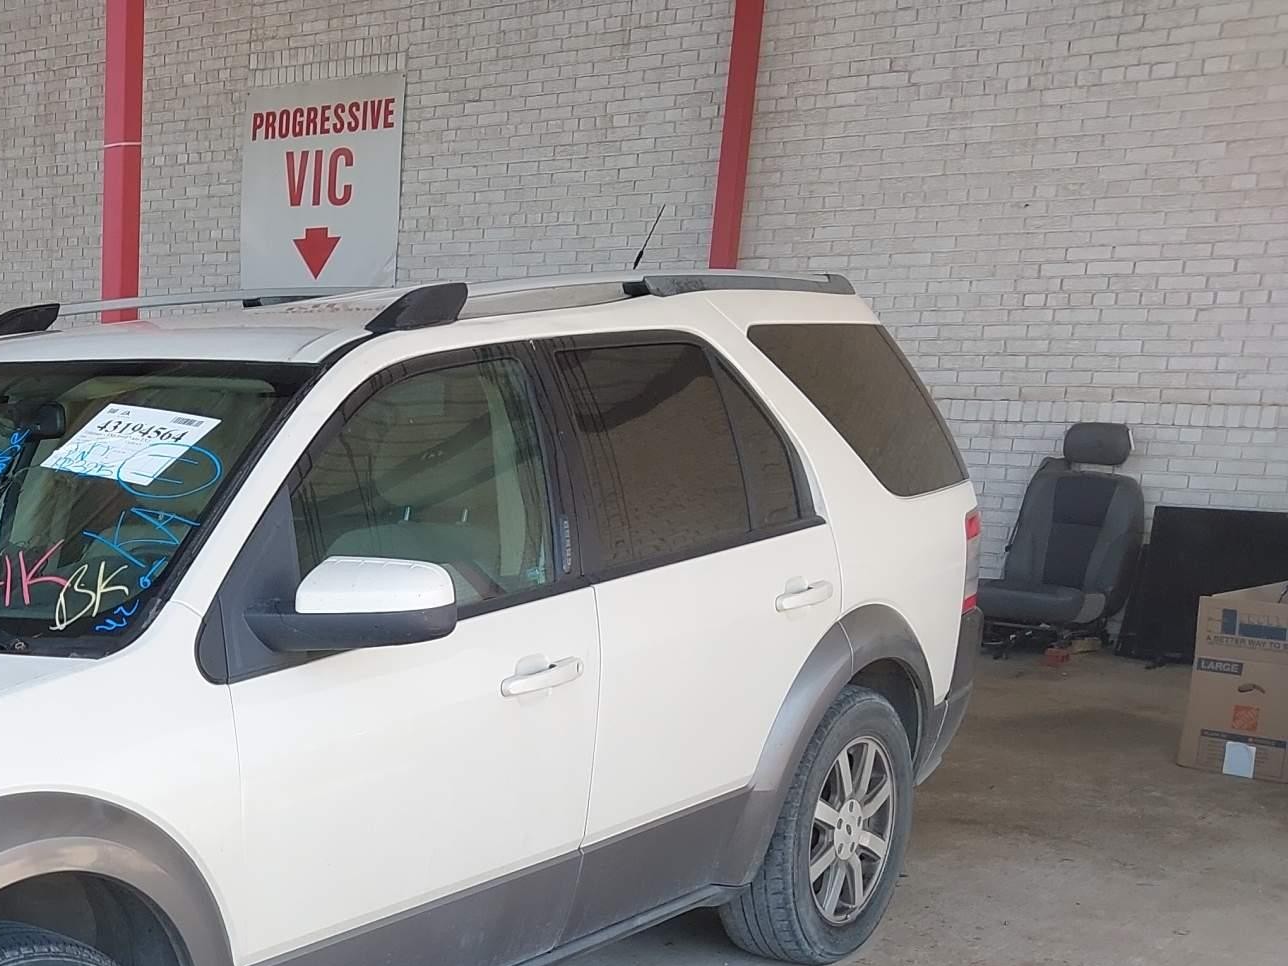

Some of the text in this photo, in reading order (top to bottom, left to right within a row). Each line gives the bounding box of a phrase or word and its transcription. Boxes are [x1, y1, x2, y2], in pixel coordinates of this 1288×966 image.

[251, 97, 396, 141] PROGRESSIVE
[285, 147, 355, 208] VIC
[97, 419, 189, 443] 43194564
[1248, 639, 1266, 648] WAY
[1201, 660, 1239, 673] LARGE
